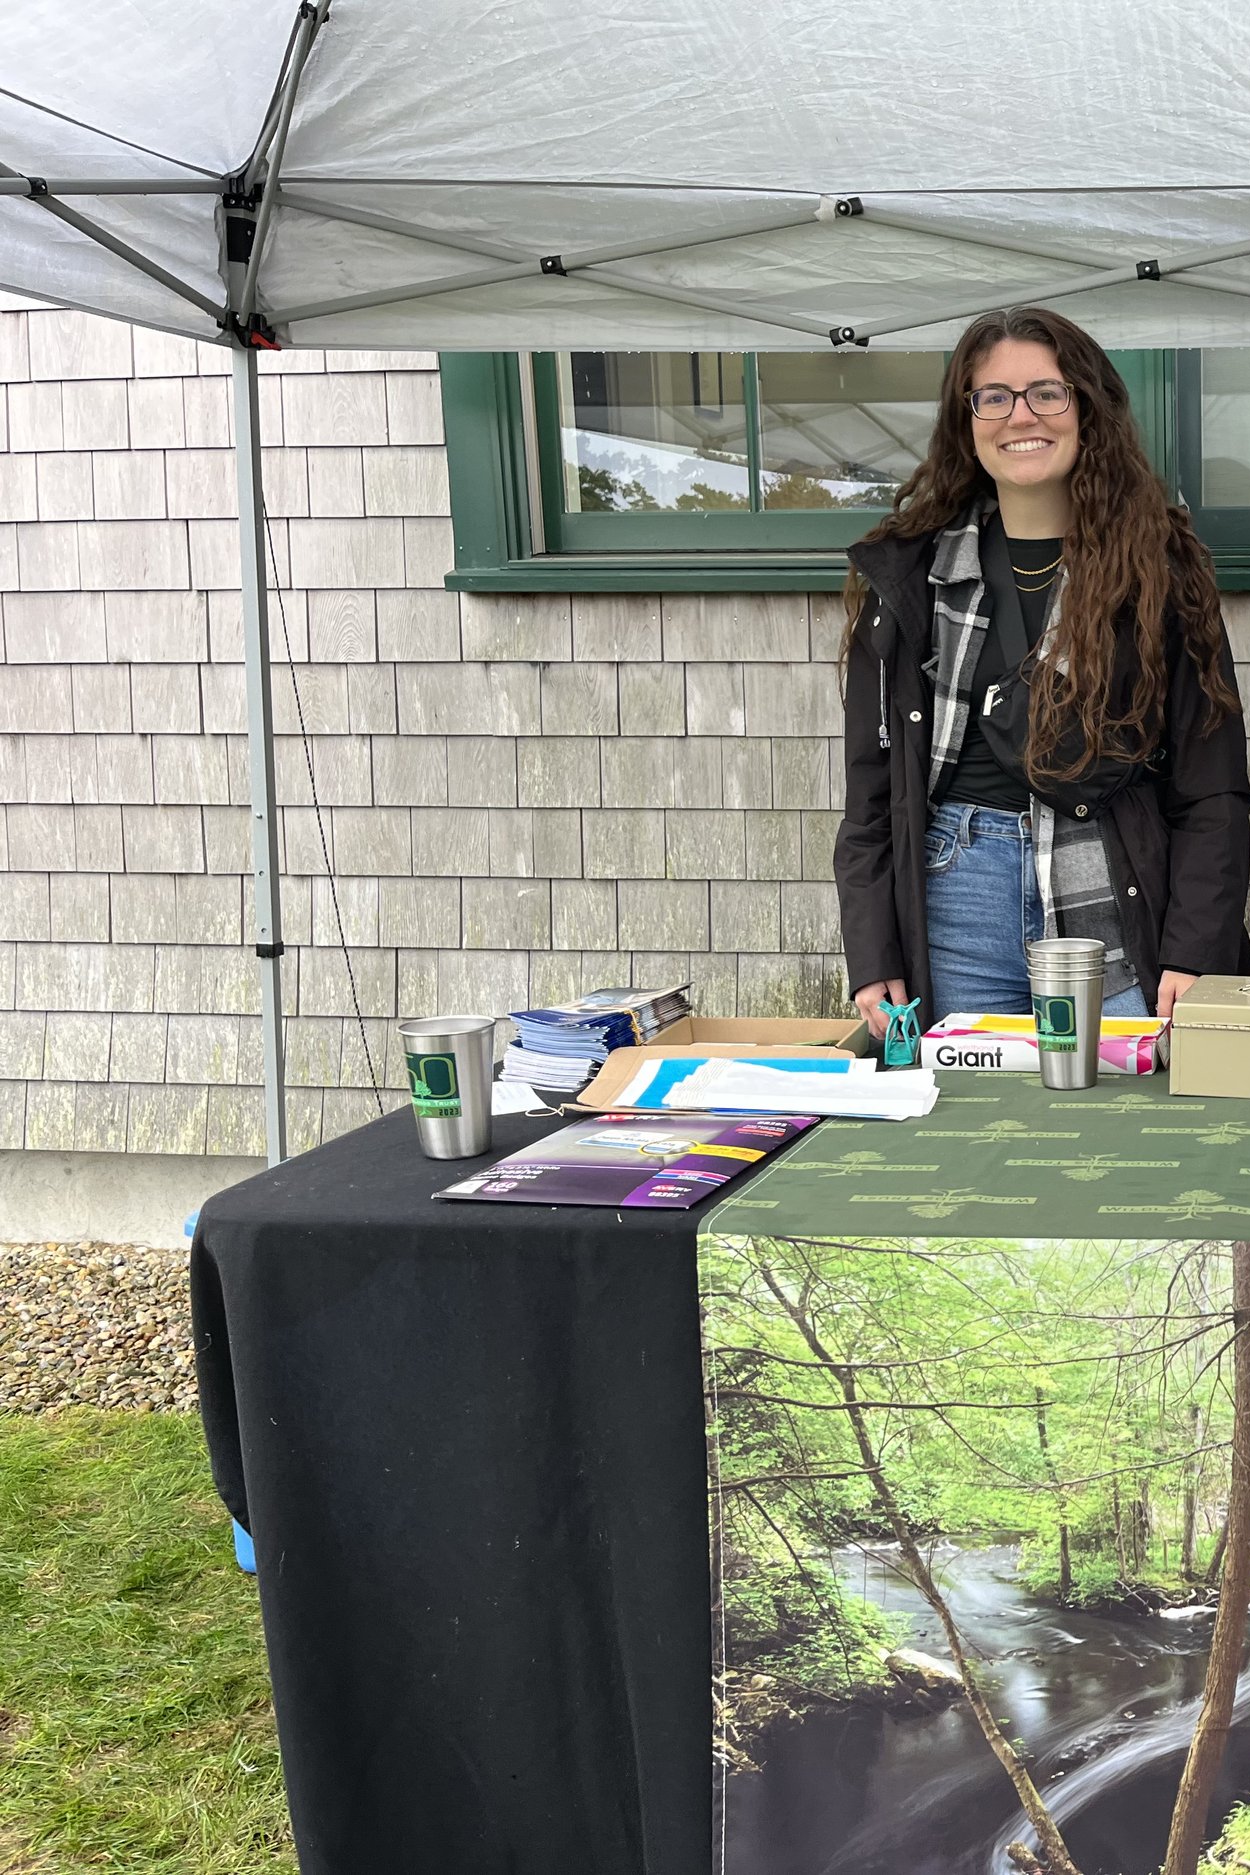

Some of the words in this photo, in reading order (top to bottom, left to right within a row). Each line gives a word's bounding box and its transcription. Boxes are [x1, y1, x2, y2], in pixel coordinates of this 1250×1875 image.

[936, 1045, 1003, 1068] Giant
[439, 1108, 459, 1116] 2023
[652, 1184, 693, 1192] AVERY
